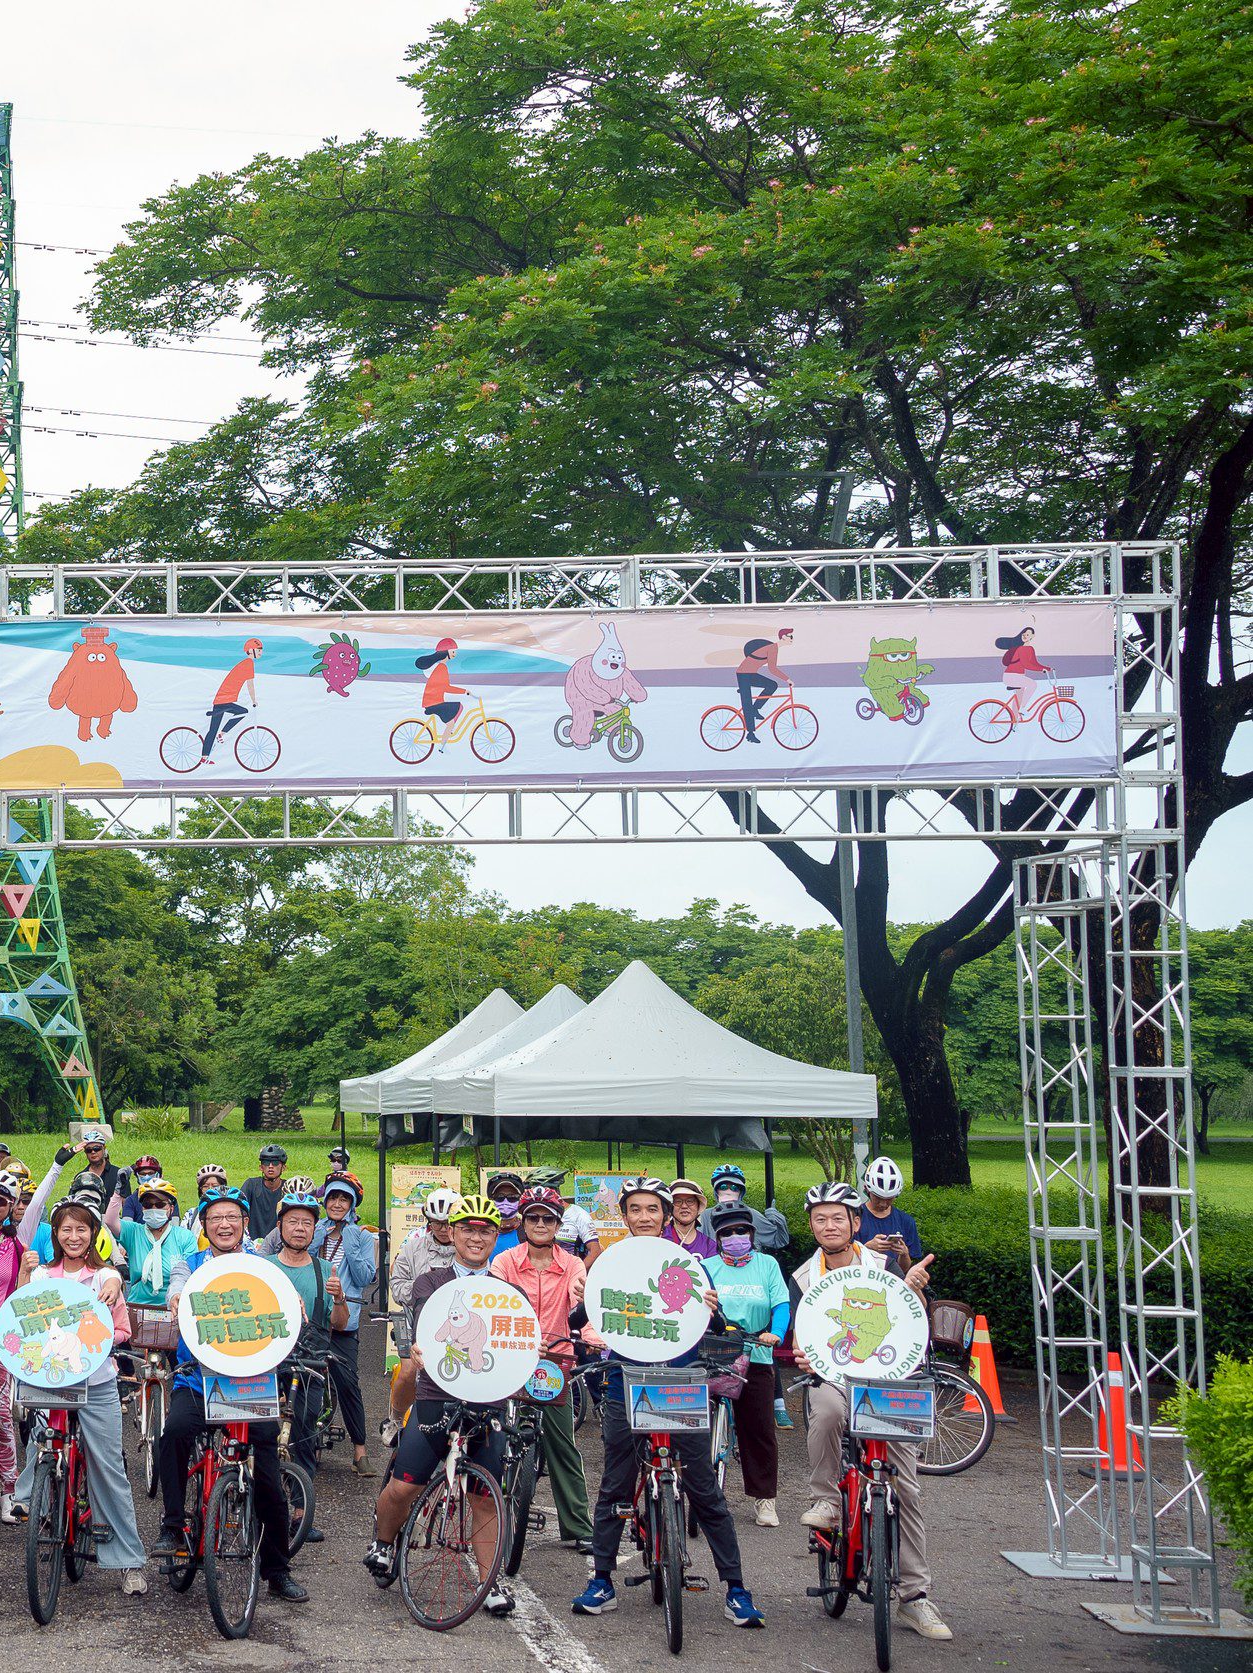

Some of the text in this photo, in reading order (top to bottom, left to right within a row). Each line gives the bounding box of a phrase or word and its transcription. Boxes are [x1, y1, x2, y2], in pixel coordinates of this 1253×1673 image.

[10, 1289, 65, 1318] 騎來
[189, 1288, 253, 1317] 騎來
[471, 1293, 523, 1310] 2026
[600, 1287, 653, 1315] 騎來
[805, 1268, 862, 1306] PINGTUNG
[867, 1269, 897, 1288] BIKE
[899, 1286, 923, 1320] TOUR
[196, 1312, 291, 1346] 屏東玩
[490, 1314, 536, 1338] 屏東
[601, 1311, 681, 1343] 屏東玩
[490, 1340, 536, 1351] 單車旅遊季
[804, 1344, 830, 1376] TOUR
